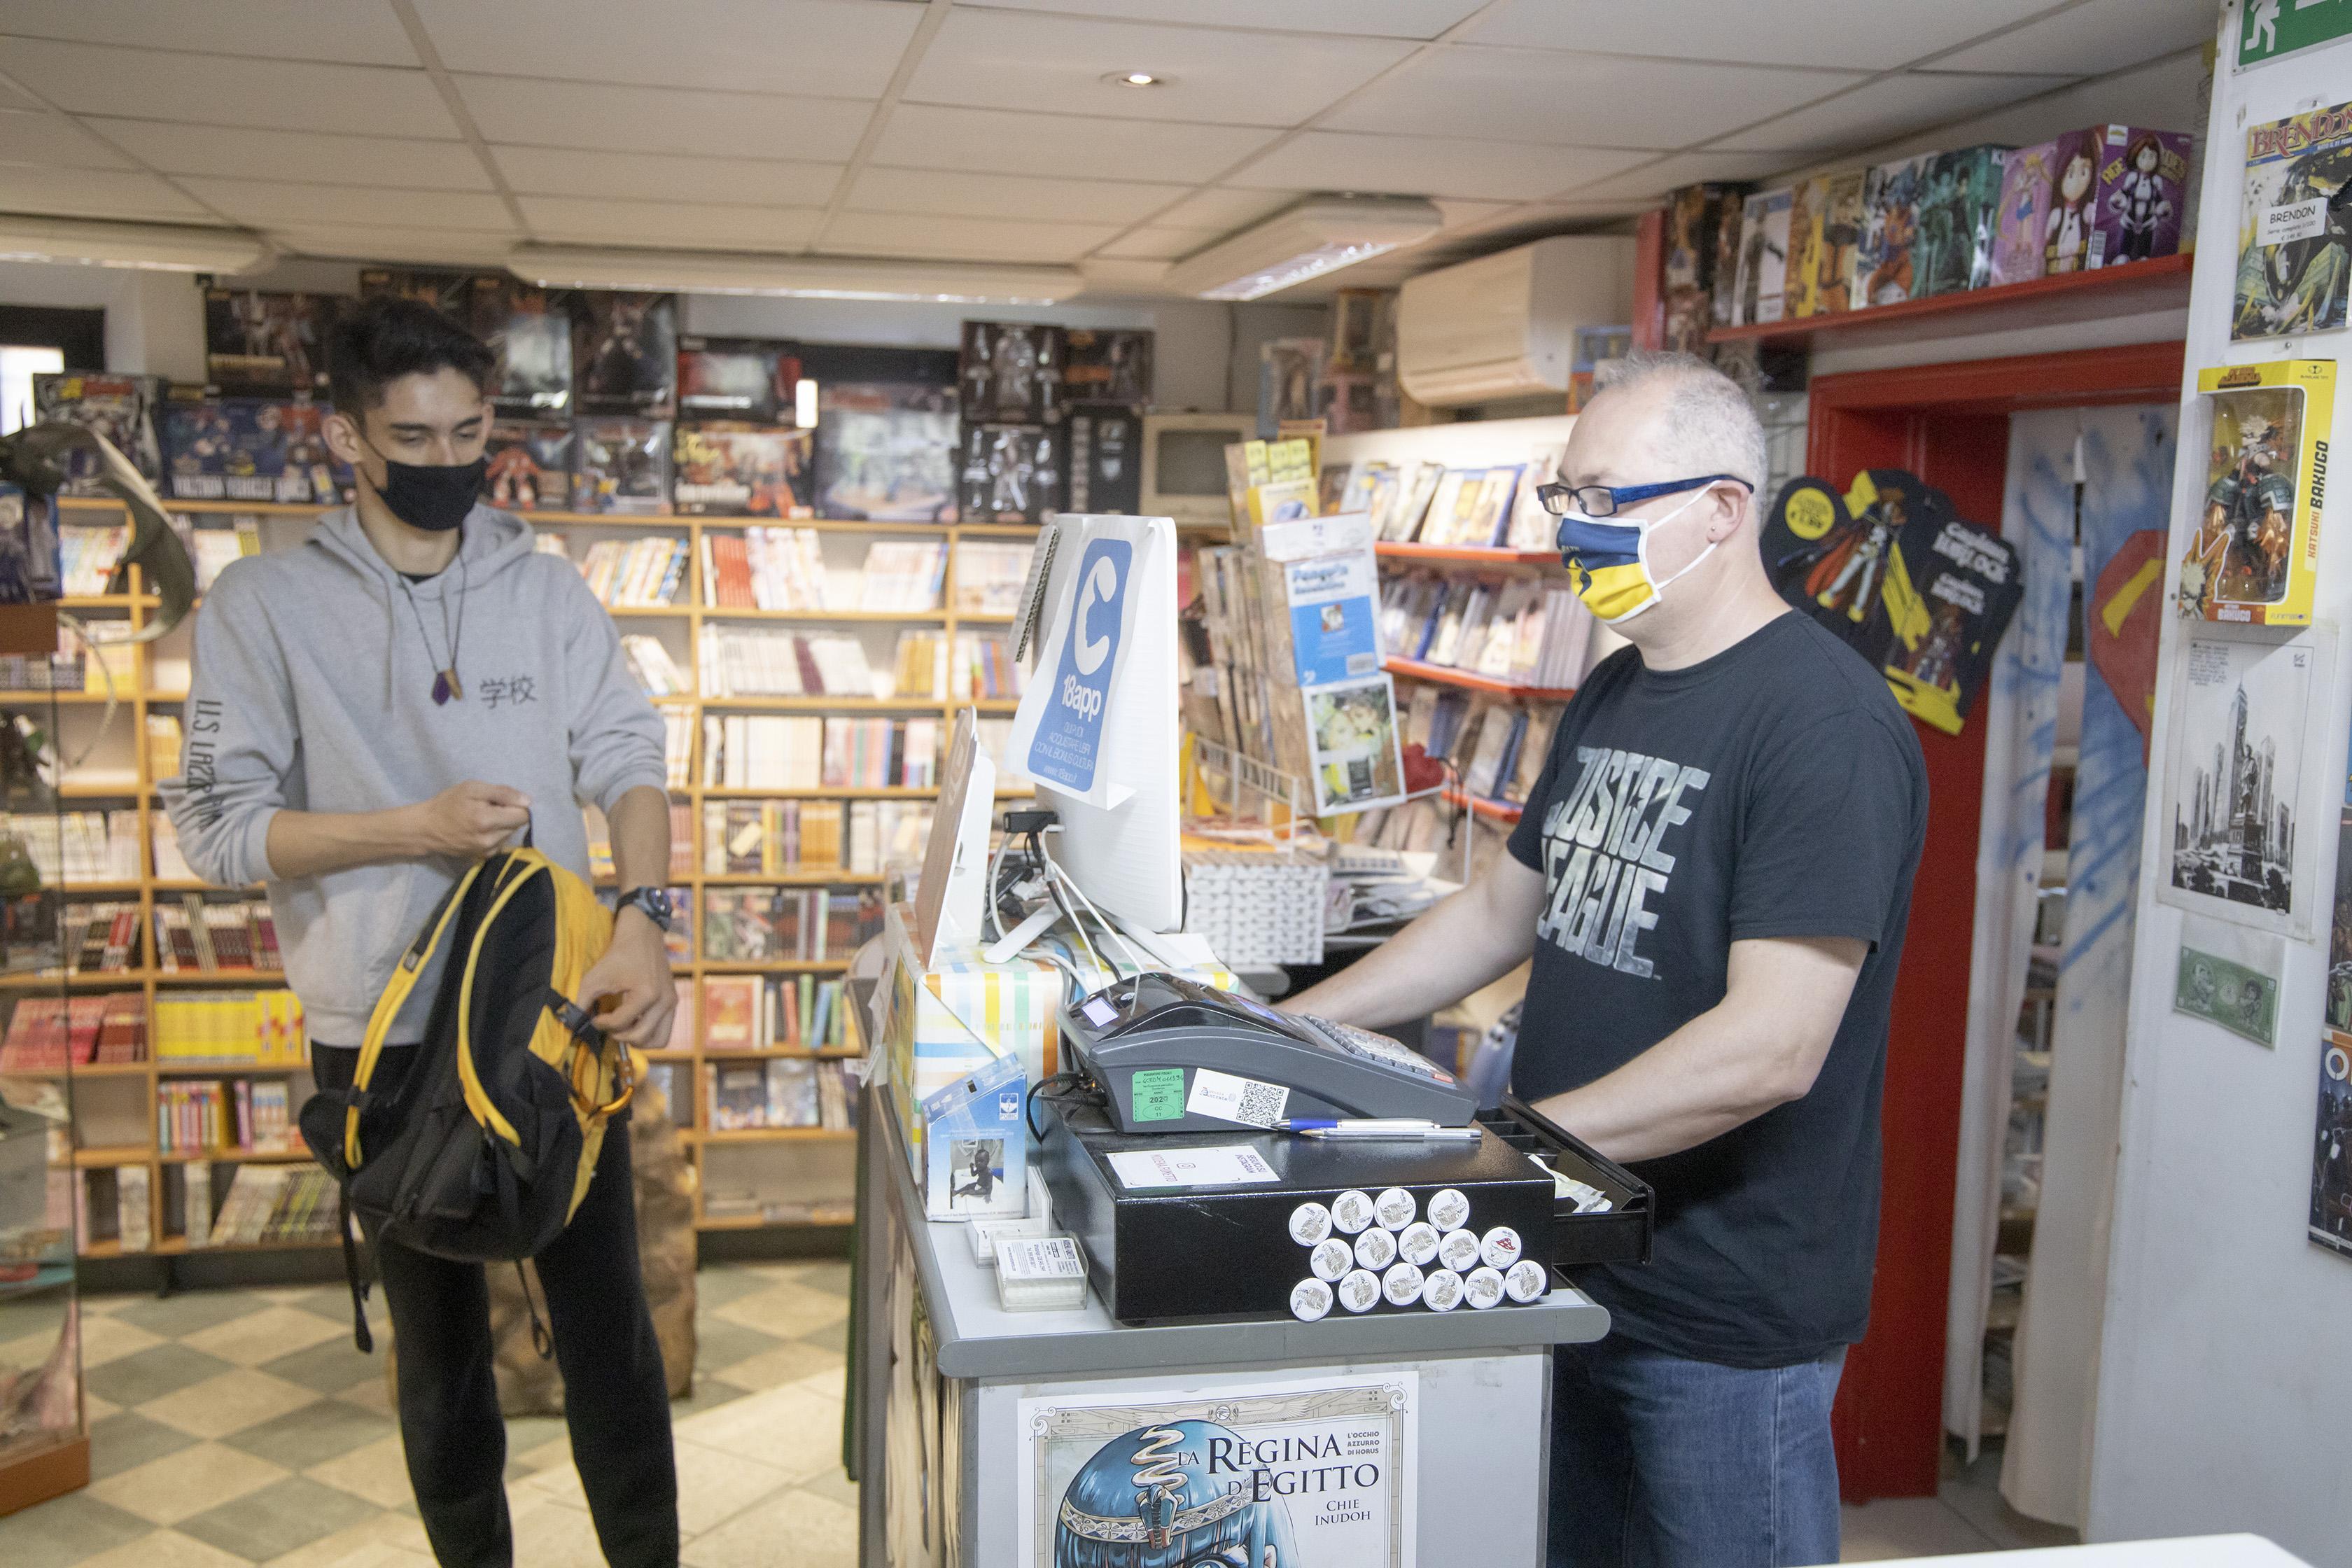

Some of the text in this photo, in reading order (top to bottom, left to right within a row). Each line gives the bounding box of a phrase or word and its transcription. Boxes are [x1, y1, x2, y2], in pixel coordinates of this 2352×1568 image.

[2269, 205, 2316, 224] BRENDON
[2309, 440, 2330, 510] BAKUGO
[2307, 512, 2320, 559] KATSUKI
[1060, 673, 1101, 722] 18app
[1542, 746, 1711, 874] JUSTICE
[1177, 1433, 1342, 1476] LA REGINA
[1227, 1464, 1380, 1504] D'EGITTO
[1315, 1510, 1371, 1527] INUDOH
[1326, 1499, 1359, 1513] CHIE
